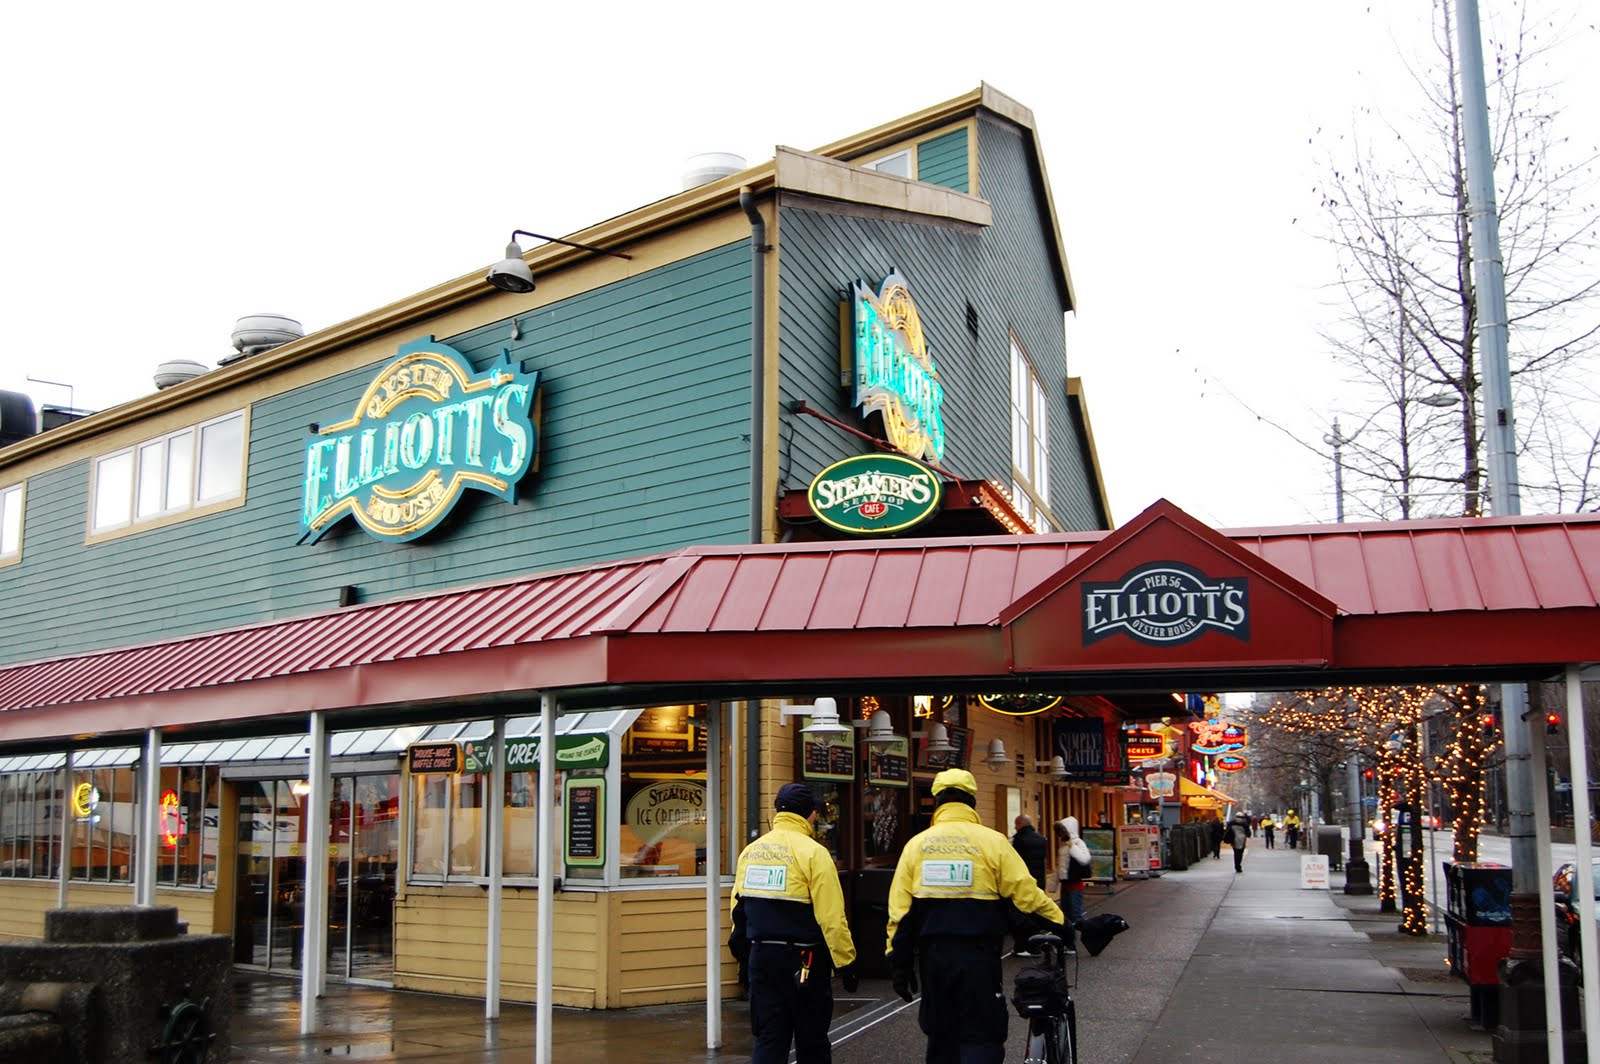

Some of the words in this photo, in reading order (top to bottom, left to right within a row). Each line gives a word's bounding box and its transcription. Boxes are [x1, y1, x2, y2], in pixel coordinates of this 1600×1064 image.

[367, 363, 455, 420] OYSTER
[302, 368, 530, 526] ELLIOTT'S
[366, 477, 449, 525] HOUSE
[815, 474, 931, 509] STEAMERS
[842, 494, 905, 509] SEAFOOD
[864, 503, 881, 514] CAFE
[1144, 574, 1168, 590] PIER
[1168, 577, 1182, 588] 56
[1085, 582, 1246, 631] ELLIOTT'S
[1132, 619, 1166, 637] OYSTER
[1167, 619, 1198, 637] HOUSE
[1059, 731, 1097, 753] SIMPLY
[507, 742, 541, 766] CREA
[636, 807, 652, 826] ICE
[1305, 863, 1326, 871] ATM
